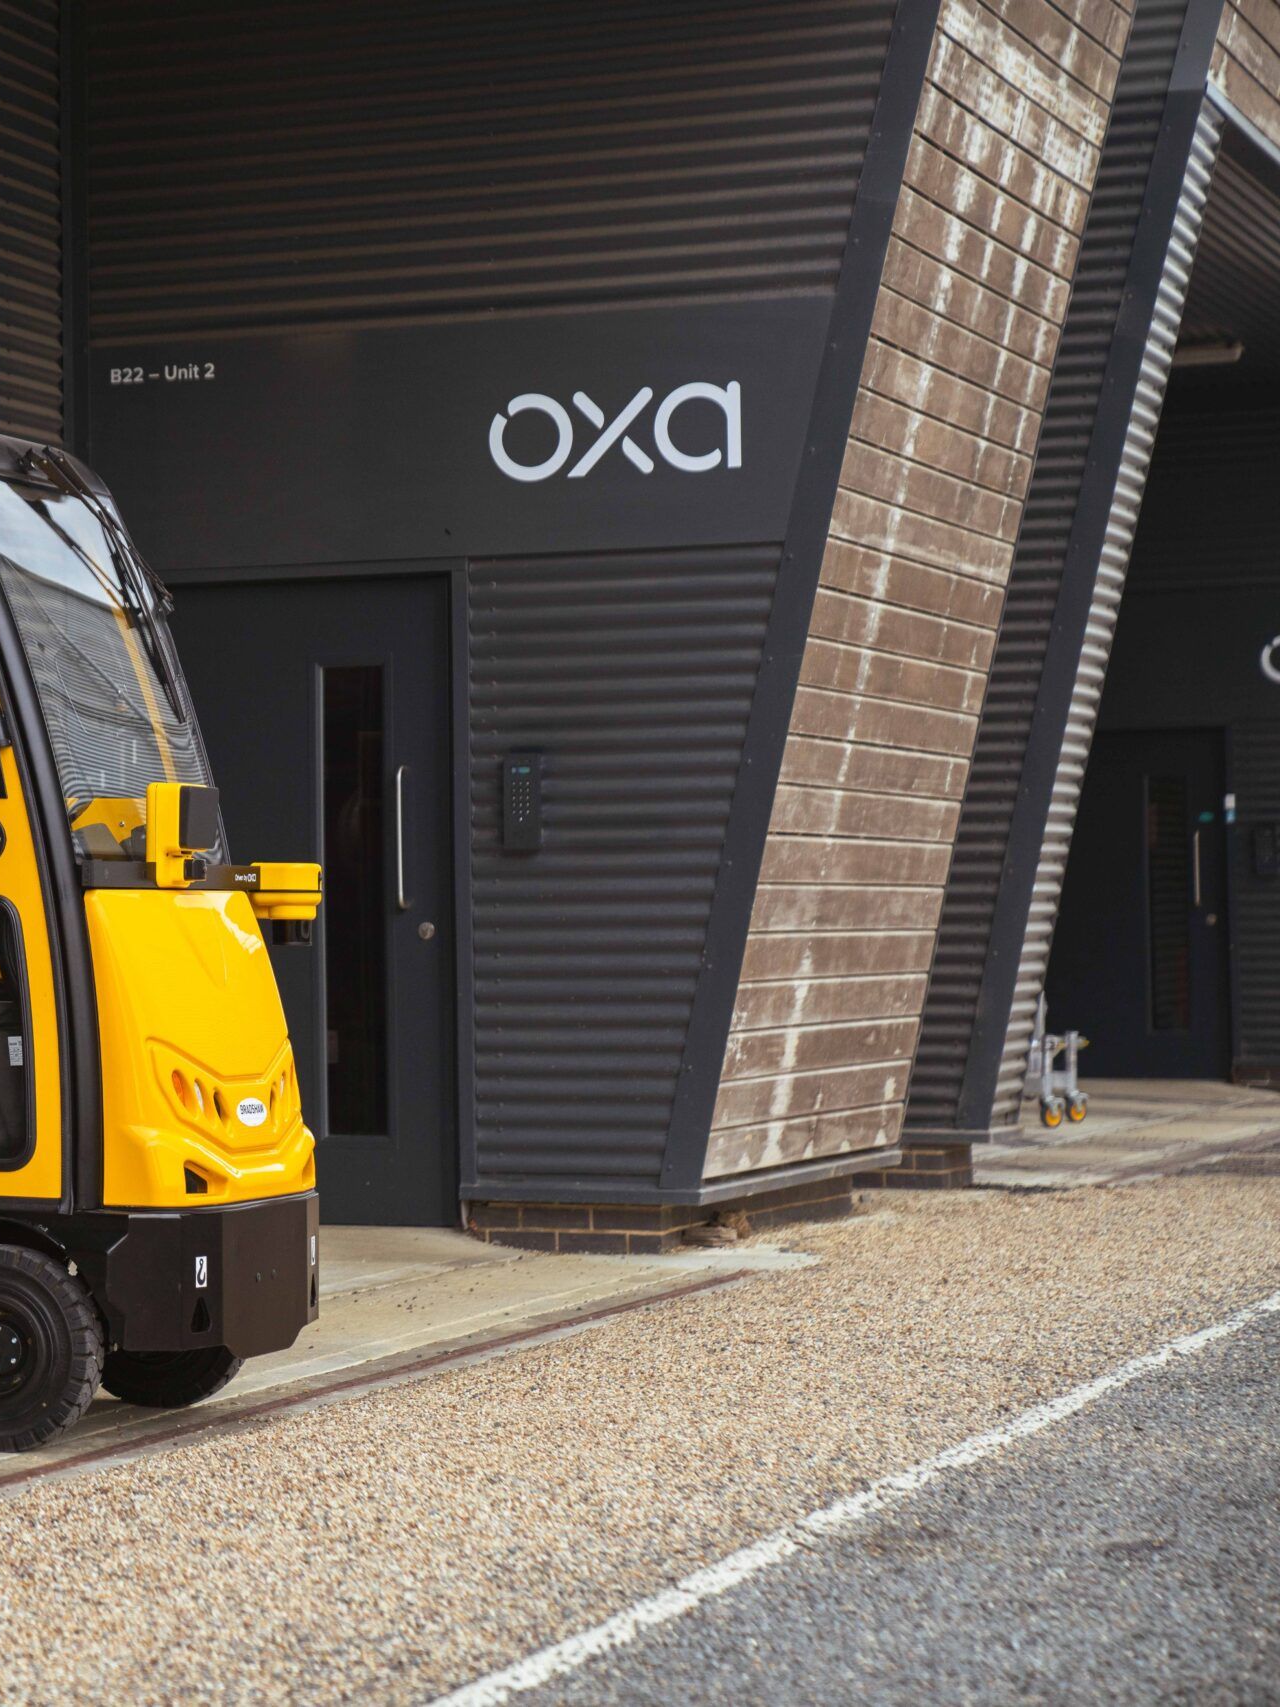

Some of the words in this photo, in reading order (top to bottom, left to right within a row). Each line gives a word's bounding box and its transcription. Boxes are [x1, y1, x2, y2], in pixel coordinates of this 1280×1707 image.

[110, 367, 144, 384] B22
[164, 363, 200, 381] Unit
[204, 363, 215, 379] 2
[489, 380, 742, 482] oxa
[240, 1104, 264, 1115] BRADSHAW
